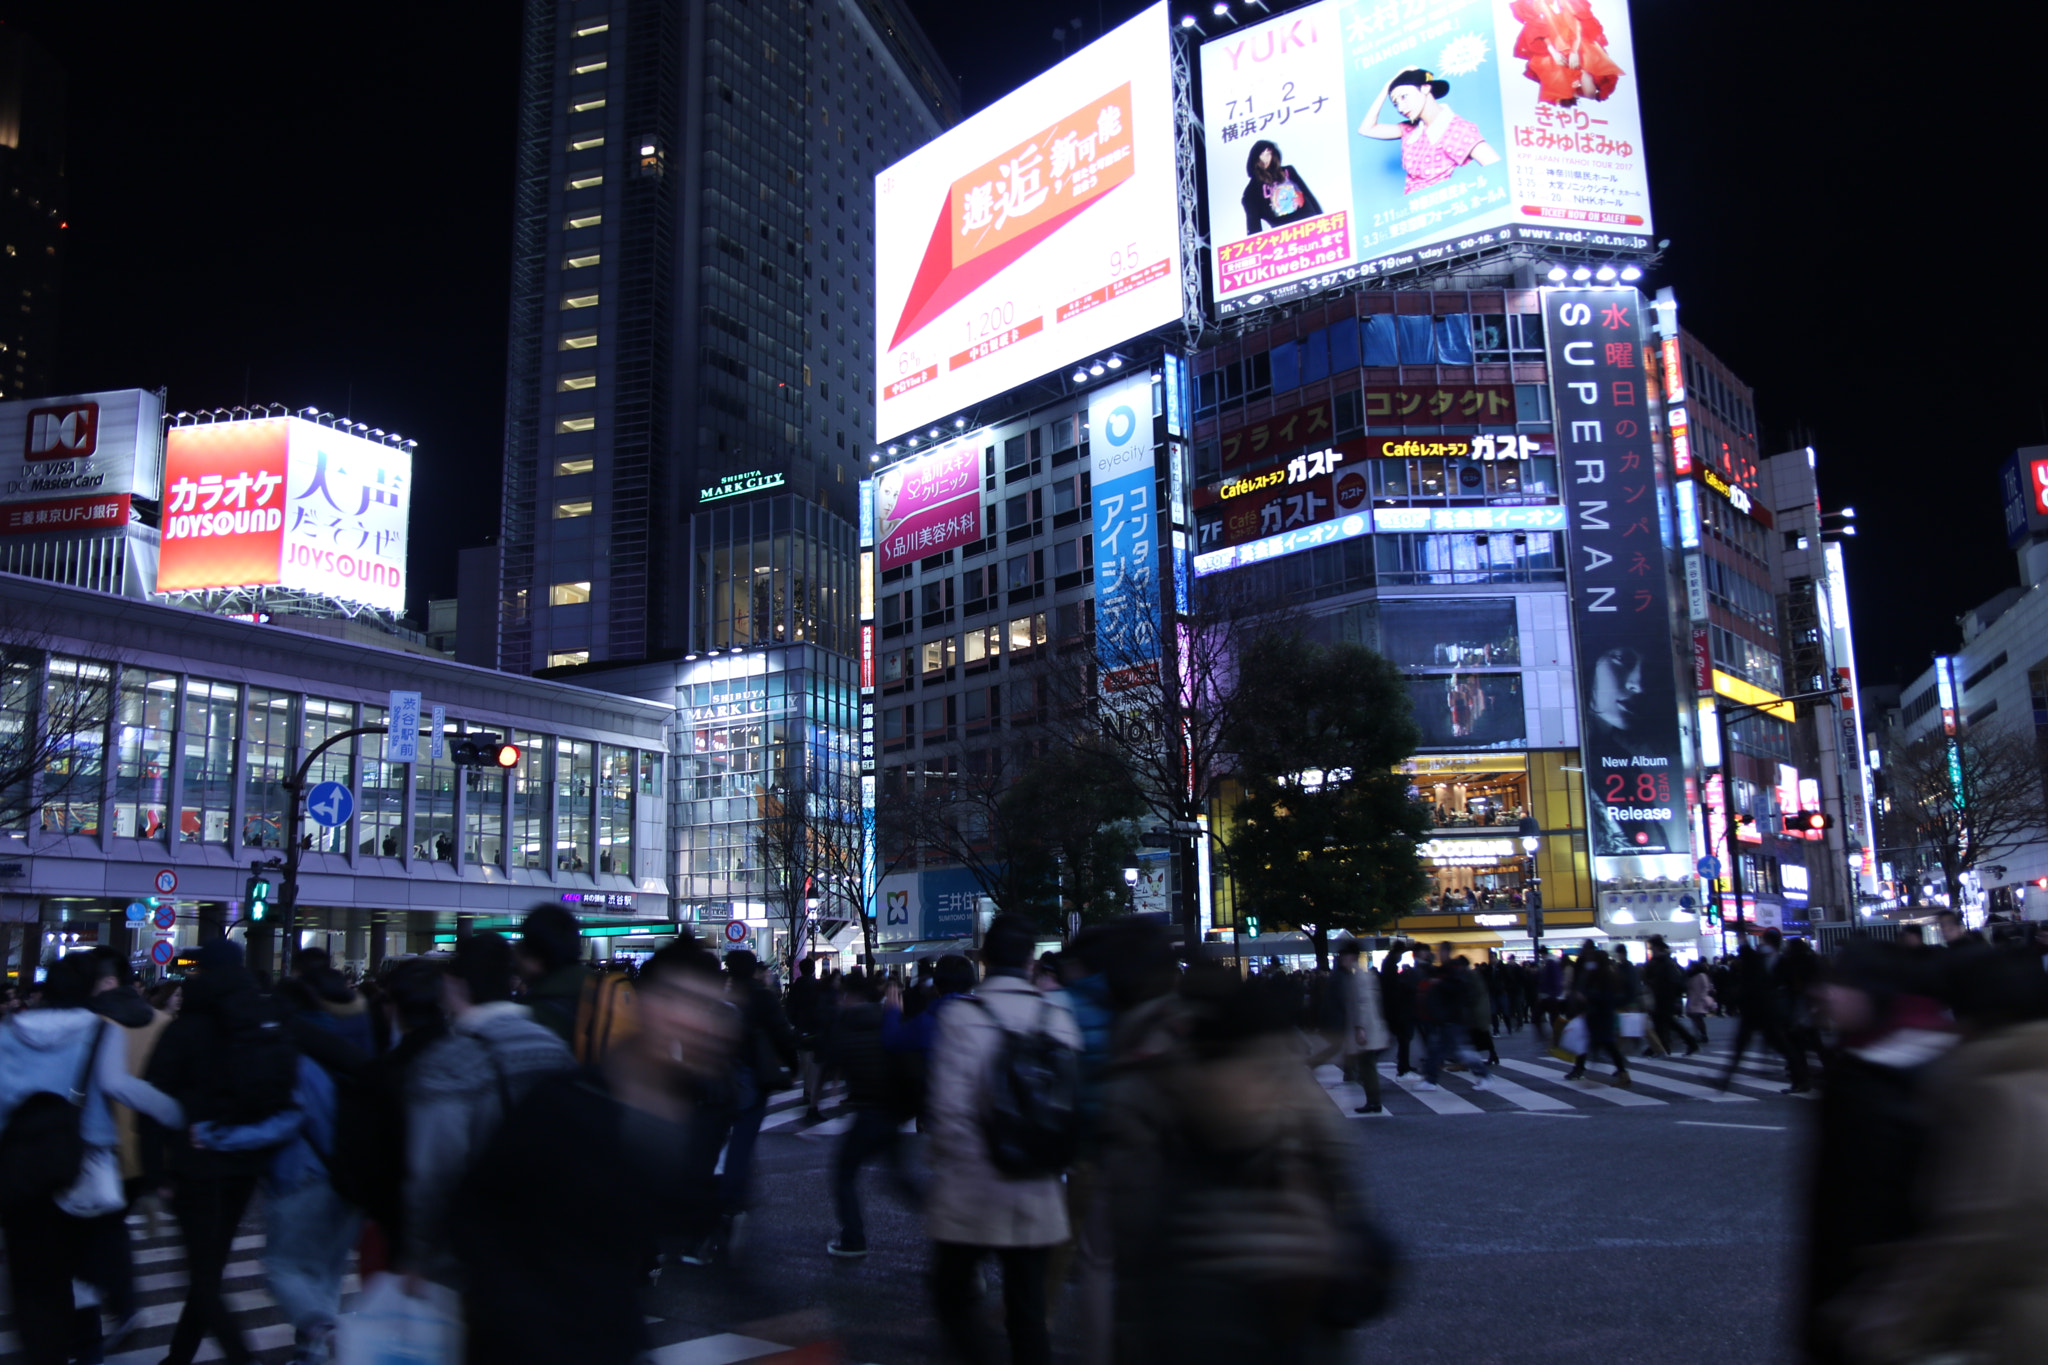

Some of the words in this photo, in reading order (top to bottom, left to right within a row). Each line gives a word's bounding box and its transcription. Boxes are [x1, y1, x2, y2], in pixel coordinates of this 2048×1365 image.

[1223, 16, 1318, 71] YUKI
[1222, 94, 1329, 144] 横浜アリーナ
[1535, 104, 1609, 130] きゃりー
[1514, 125, 1633, 158] ぱみゅぱみゅ
[1535, 154, 1560, 164] JAPAN
[1592, 161, 1612, 170] TOUR
[1615, 162, 1633, 171] 2017
[1541, 207, 1566, 218] TICKET
[1568, 209, 1587, 219] NOW
[1588, 212, 1600, 221] ON
[1574, 195, 1624, 207] NHKホール
[1220, 213, 1345, 261] オフィシャルHP先行
[1110, 242, 1139, 277] 9.5
[1233, 247, 1344, 287] YUKIweb.net
[1366, 389, 1510, 416] コンタクト
[1222, 405, 1329, 462] プライス
[1471, 434, 1540, 460] ガスト
[22, 465, 43, 478] DC
[46, 460, 76, 476] VISA
[921, 452, 974, 484] 品川スキン
[1098, 445, 1146, 472] eyecity
[1287, 448, 1343, 485] ガスト
[1560, 303, 1617, 612] SUPERMAN
[1600, 303, 1652, 612] 水曜日のカンパネラ
[8, 481, 29, 494] DC
[32, 473, 106, 491] MasterCard
[700, 482, 743, 500] MARK
[746, 472, 783, 490] CITY
[721, 469, 762, 485] SHIBUYA
[921, 472, 969, 502] クリニック
[169, 471, 283, 513] カラオケ
[1340, 485, 1364, 501] ガスト
[9, 503, 119, 527] 三菱東京UFJ銀行
[166, 508, 282, 540] JOYSOUND
[1229, 509, 1257, 531] Café
[1260, 491, 1328, 537] ガスト
[1434, 508, 1563, 529] 英会話イーオン
[892, 531, 976, 558] 品川美容外科
[1200, 520, 1223, 544] 7F
[287, 542, 401, 588] JOYSOUND
[1100, 493, 1129, 650] アイシティ
[1130, 485, 1154, 646] コンタクトの
[687, 703, 742, 721] MARK
[750, 695, 798, 713] CITY
[712, 689, 766, 704] SHIBUYA
[392, 705, 401, 733] Shibuya
[401, 697, 416, 756] 渋谷駅前
[862, 703, 874, 757] 加藤眼科
[863, 760, 874, 769] 5F
[1602, 756, 1628, 768] New
[1631, 755, 1668, 767] Album
[1605, 773, 1657, 802] 2.8
[1658, 772, 1671, 802] WED
[1607, 806, 1672, 821] Release
[608, 895, 632, 906] 渋谷駅
